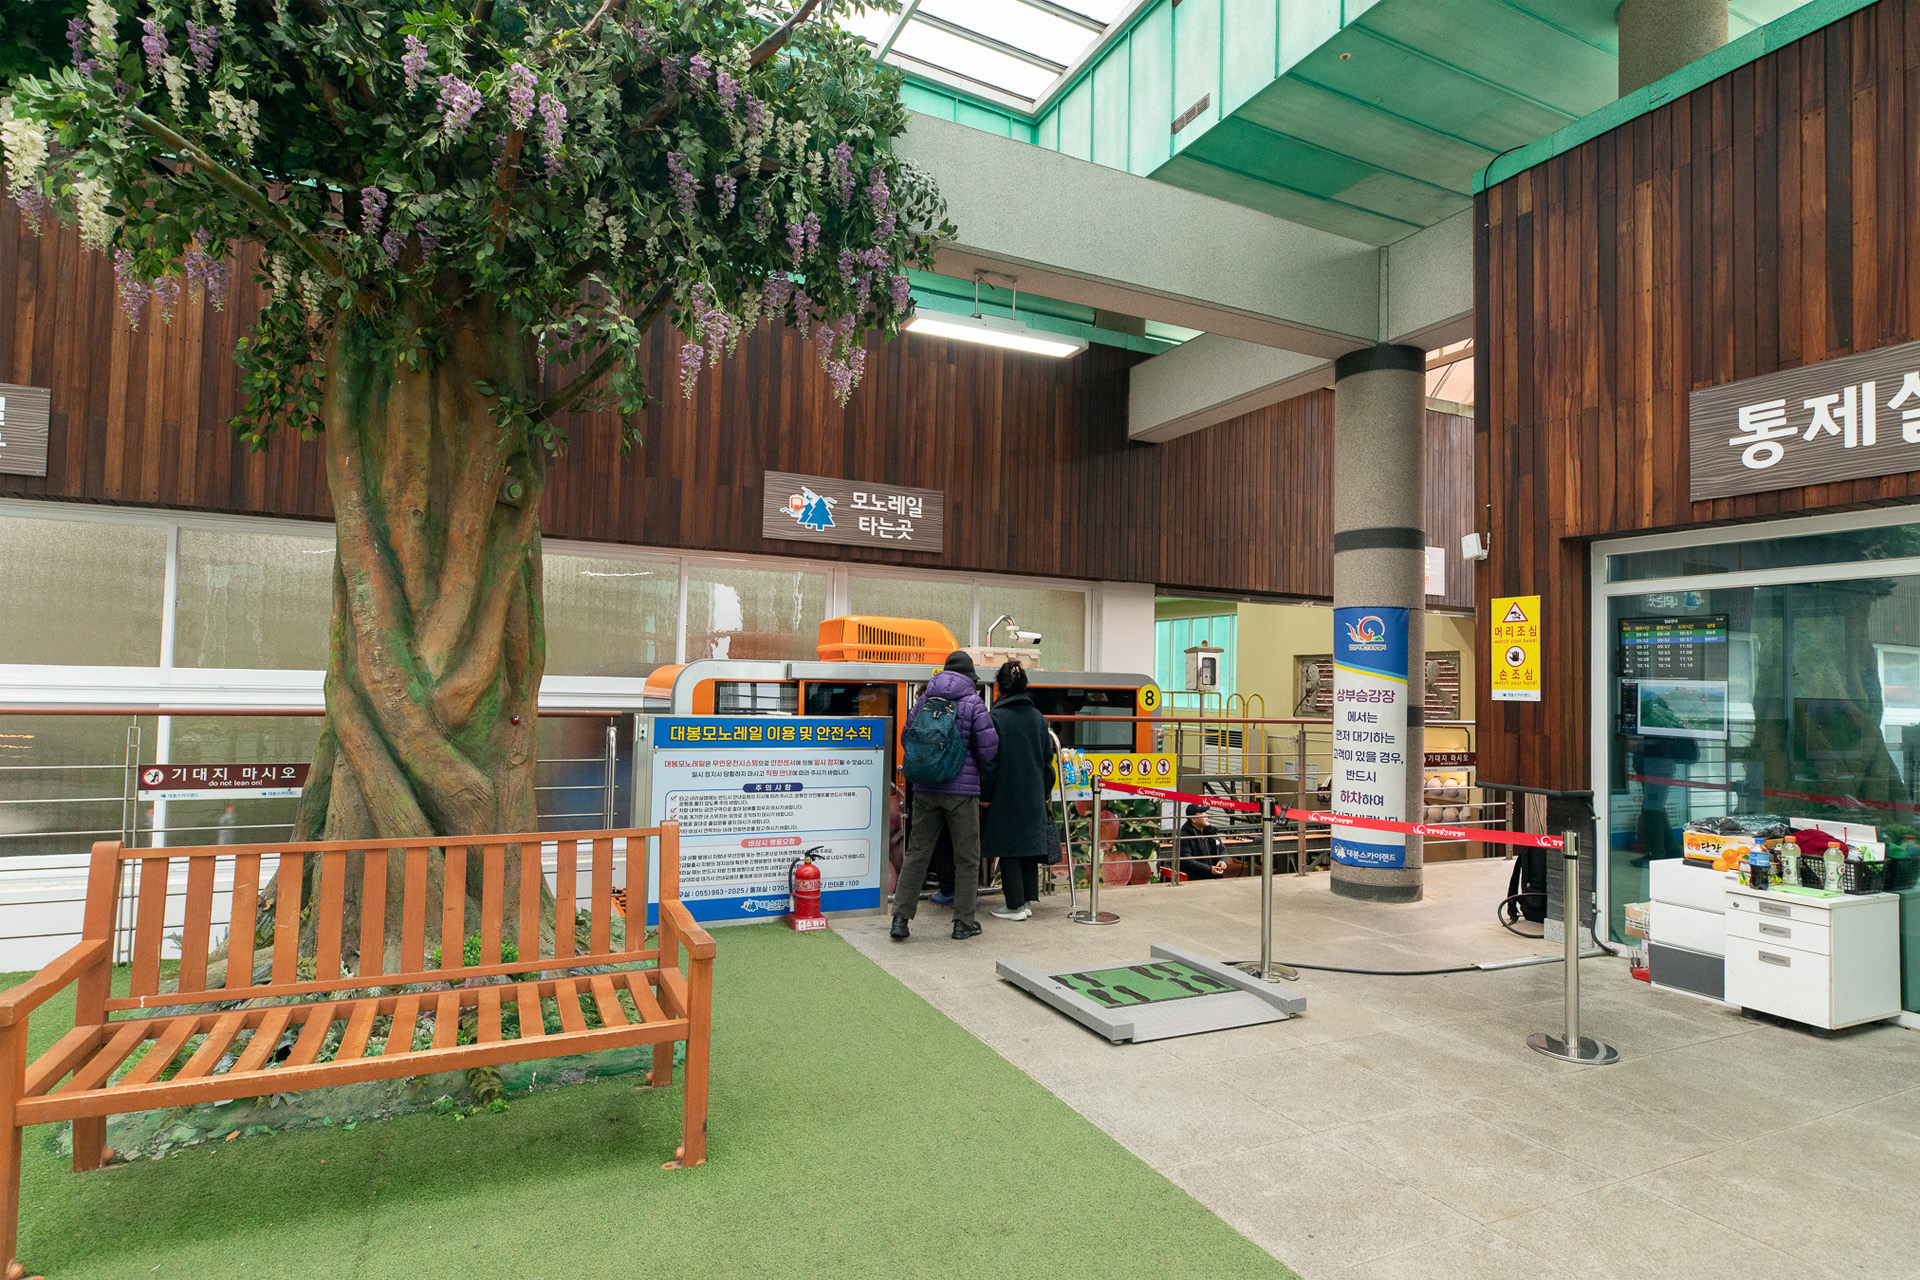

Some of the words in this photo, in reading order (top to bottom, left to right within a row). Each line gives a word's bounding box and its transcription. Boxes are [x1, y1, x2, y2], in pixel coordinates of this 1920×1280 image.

[851, 492, 922, 518] 모노레일
[859, 516, 914, 540] 타는곳
[1495, 625, 1537, 637] 머리조심
[1499, 669, 1533, 680] 손조심
[1145, 690, 1154, 706] 8
[1337, 689, 1395, 703] 상부승강장
[1348, 711, 1378, 723] 에서는
[670, 726, 762, 741] 대봉모노레일
[767, 726, 796, 741] 이용
[799, 726, 812, 741] 및
[816, 726, 871, 741] 안전수칙
[1336, 730, 1350, 741] 먼저
[1353, 730, 1395, 744] 대기하는
[1334, 749, 1353, 761] 고객이
[1356, 750, 1376, 763] 있을
[1380, 752, 1404, 765] 경우,
[171, 767, 228, 781] 기대지
[242, 766, 296, 780] 마시오
[1346, 770, 1376, 783] 반드시
[1340, 790, 1384, 806] 하차하여
[1347, 849, 1396, 863] 대봉스카이랜드
[695, 888, 744, 896] 055)963-2025
